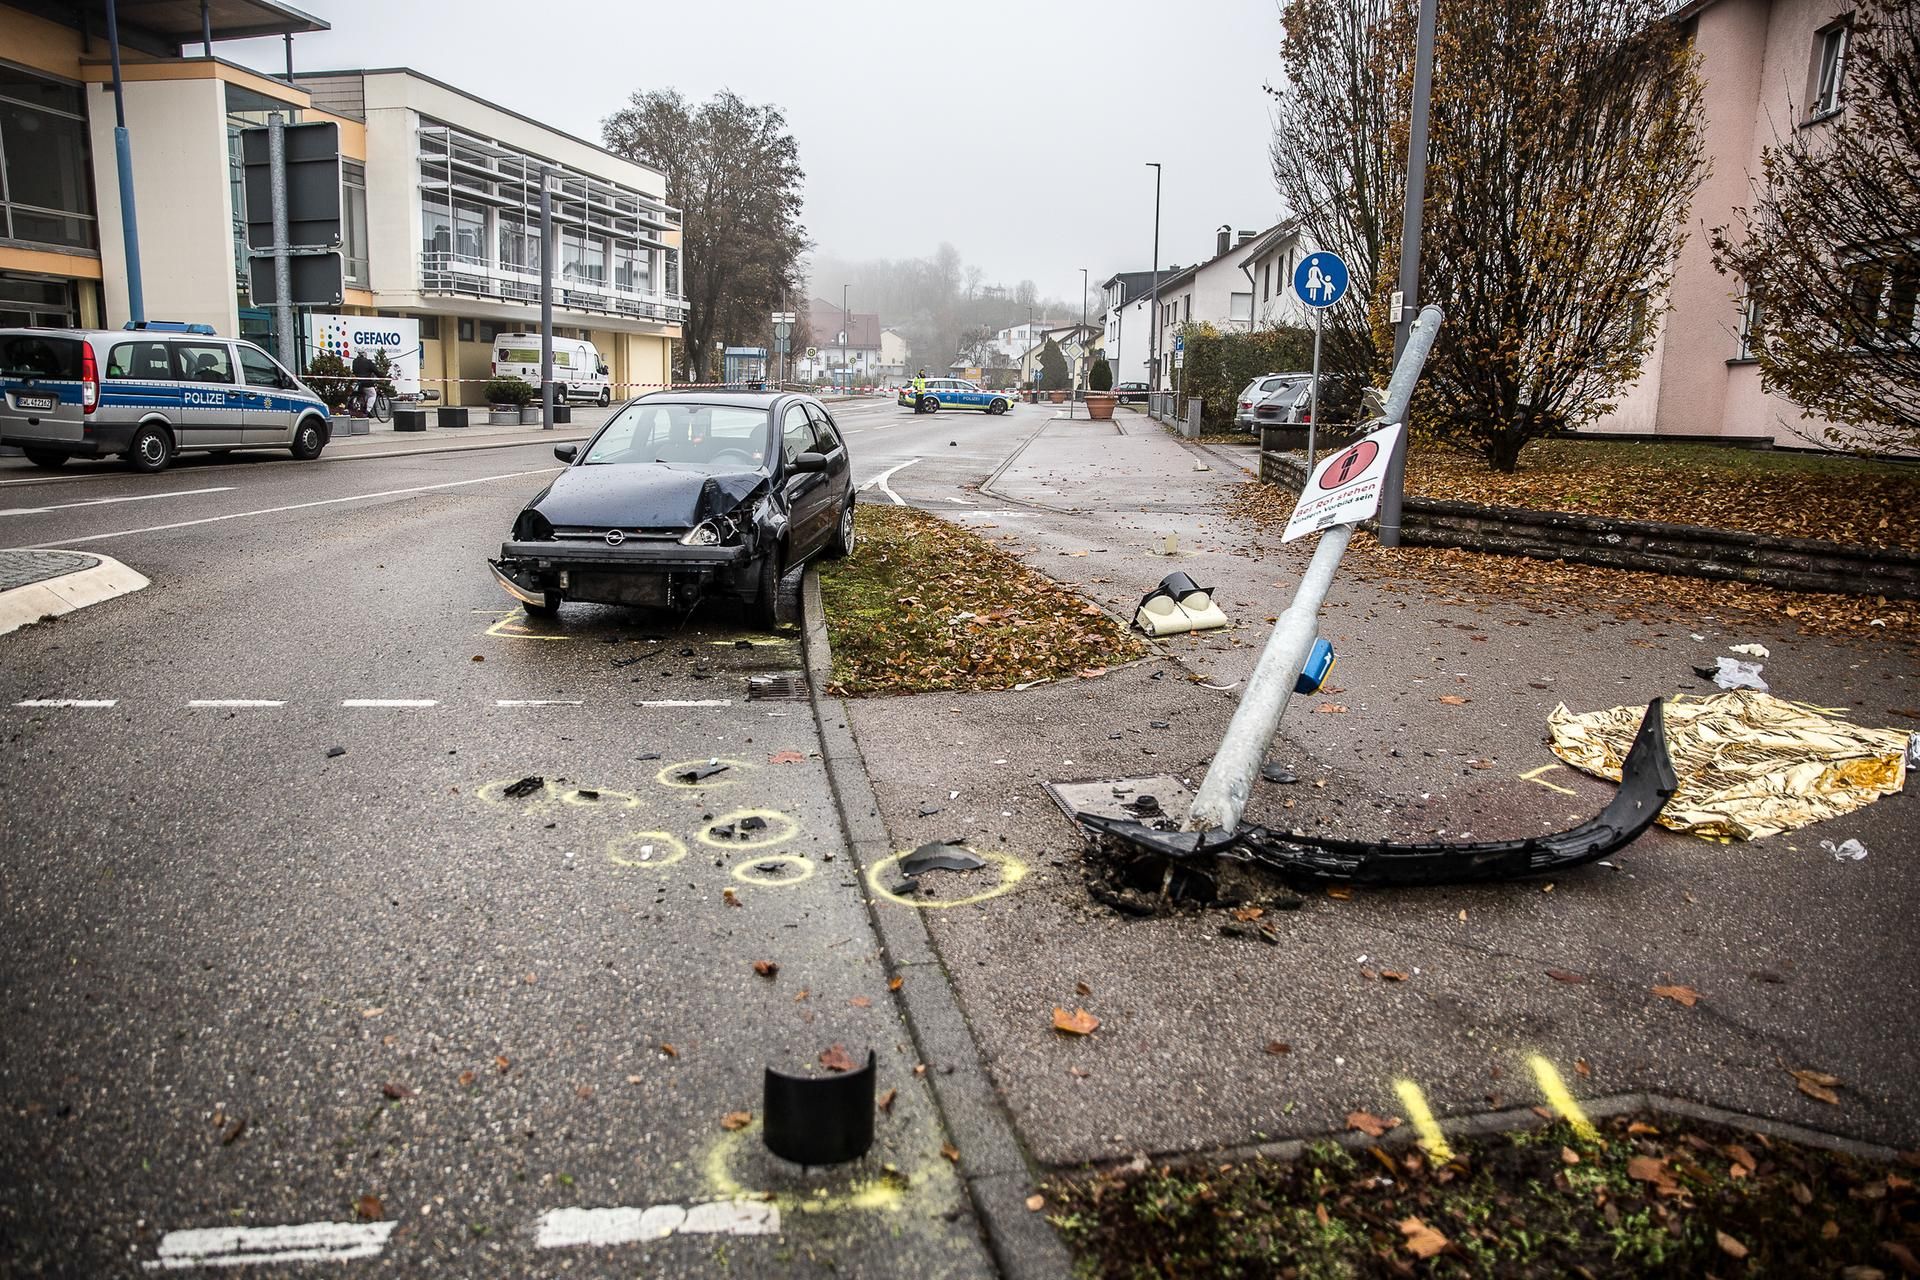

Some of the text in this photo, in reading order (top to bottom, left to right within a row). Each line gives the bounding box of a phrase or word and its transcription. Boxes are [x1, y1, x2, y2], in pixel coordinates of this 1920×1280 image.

[354, 331, 401, 345] GEFAKO
[184, 392, 225, 405] POLIZEI
[1296, 483, 1376, 517] Bei Rot stehen
[1355, 493, 1374, 502] sein
